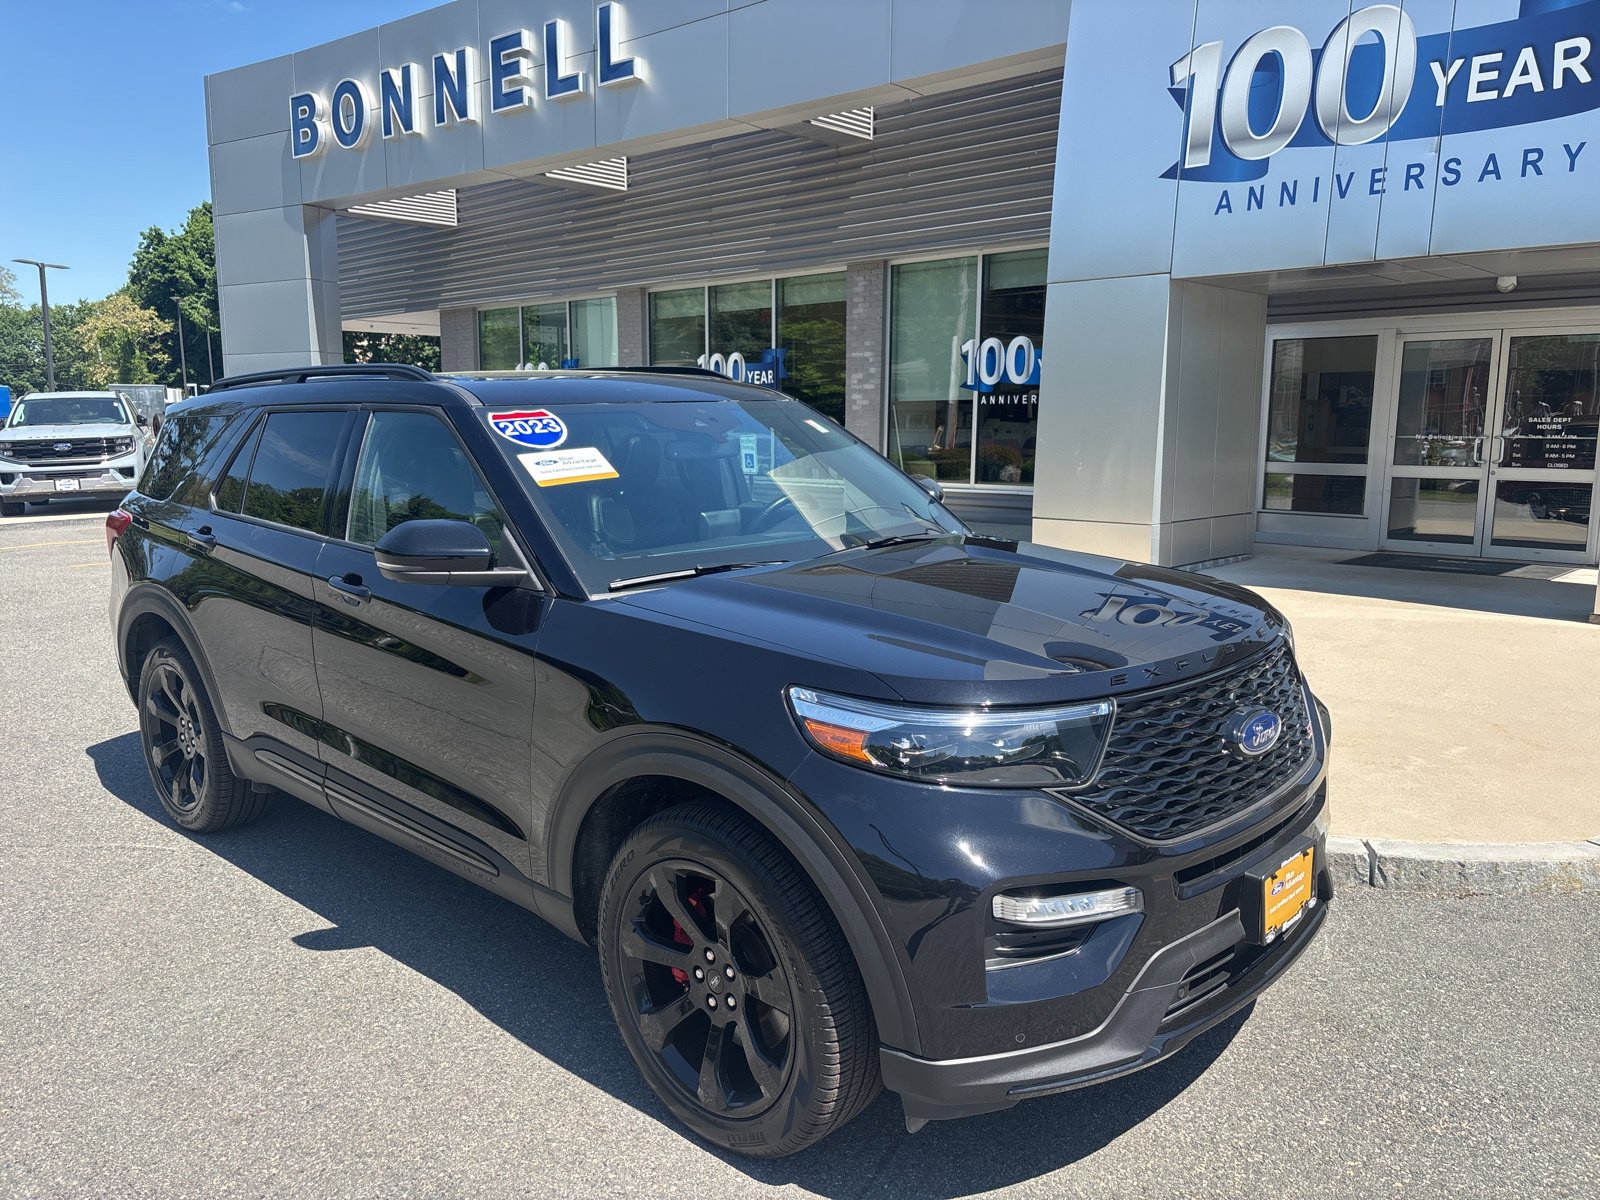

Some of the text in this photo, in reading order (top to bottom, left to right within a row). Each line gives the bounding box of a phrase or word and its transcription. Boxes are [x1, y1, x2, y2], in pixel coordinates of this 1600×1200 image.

[289, 1, 643, 160] BONNELL
[1169, 4, 1593, 169] 100 YEAR
[1213, 141, 1588, 216] ANNIVERSARY
[747, 370, 775, 384] YEAR
[961, 335, 1035, 386] 100
[980, 394, 1038, 405] ANNIVER
[498, 418, 562, 437] 2023
